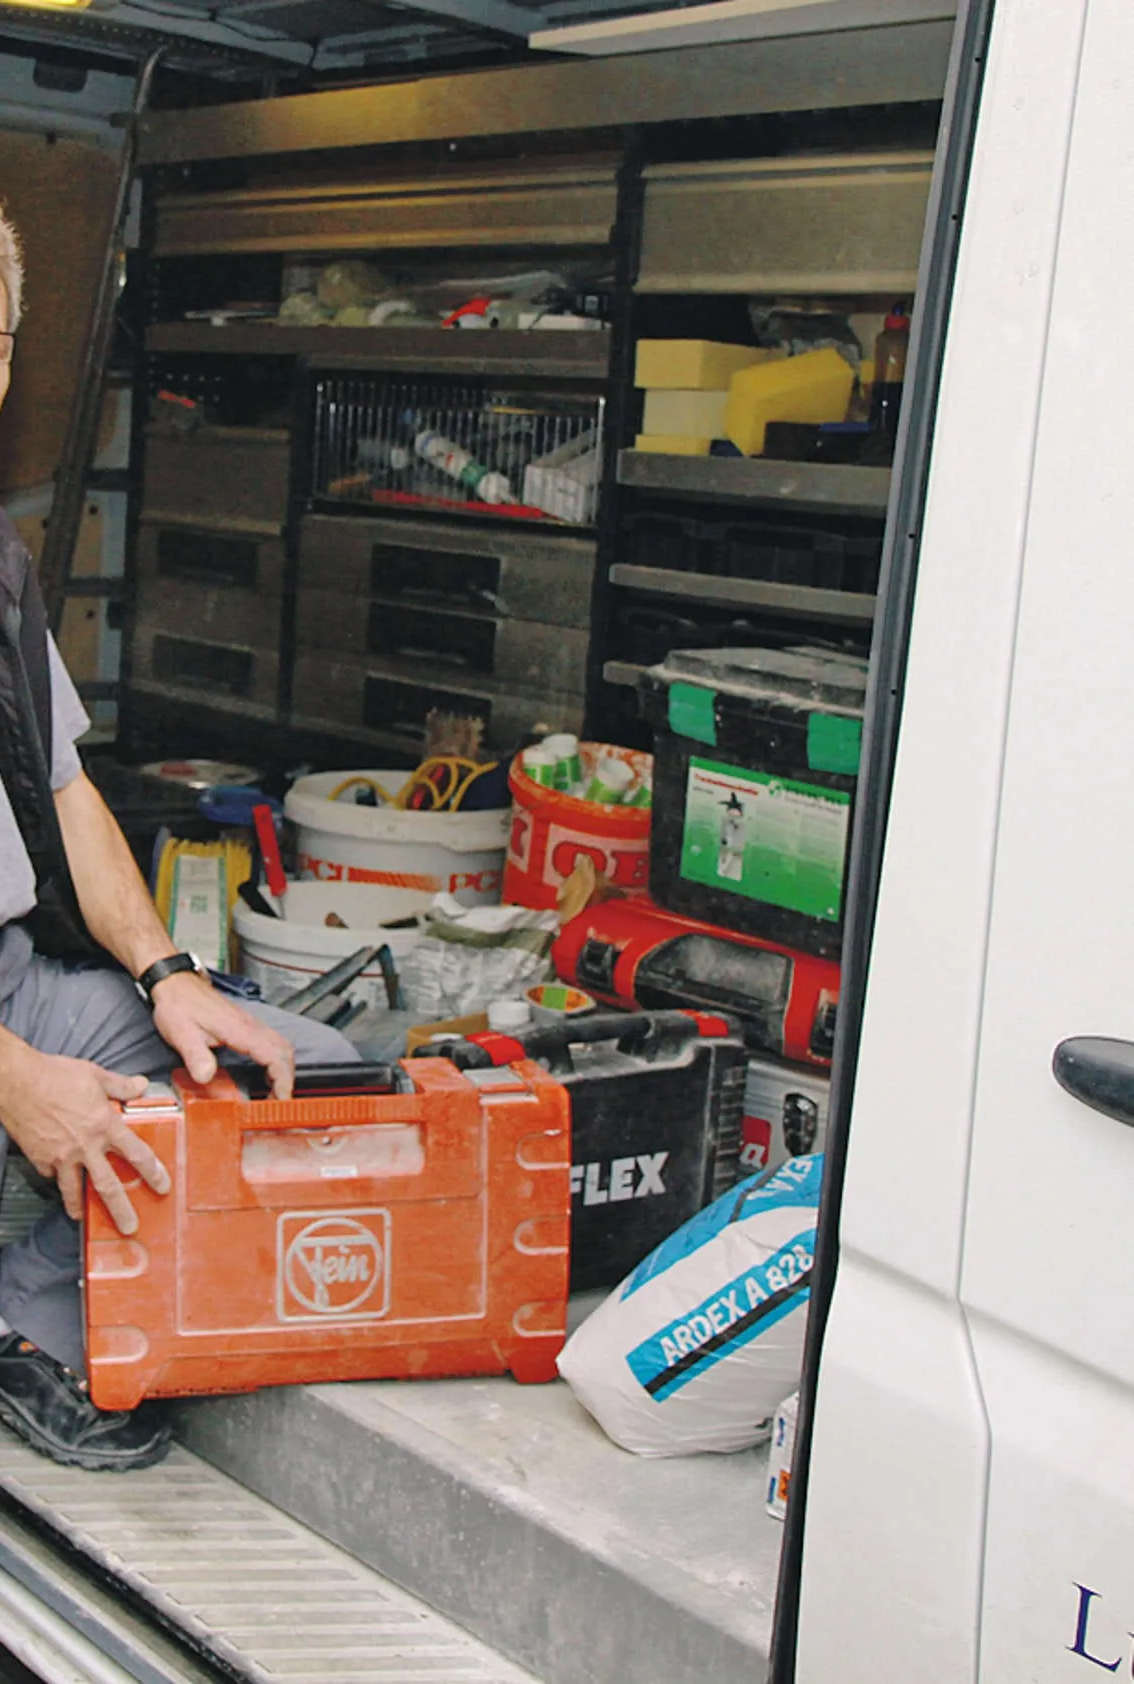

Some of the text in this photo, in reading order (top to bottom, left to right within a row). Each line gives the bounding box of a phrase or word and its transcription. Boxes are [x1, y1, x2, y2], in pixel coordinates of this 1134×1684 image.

[569, 1151, 670, 1206] FLEX
[660, 1289, 746, 1367] ARDEX
[745, 1277, 769, 1309] A
